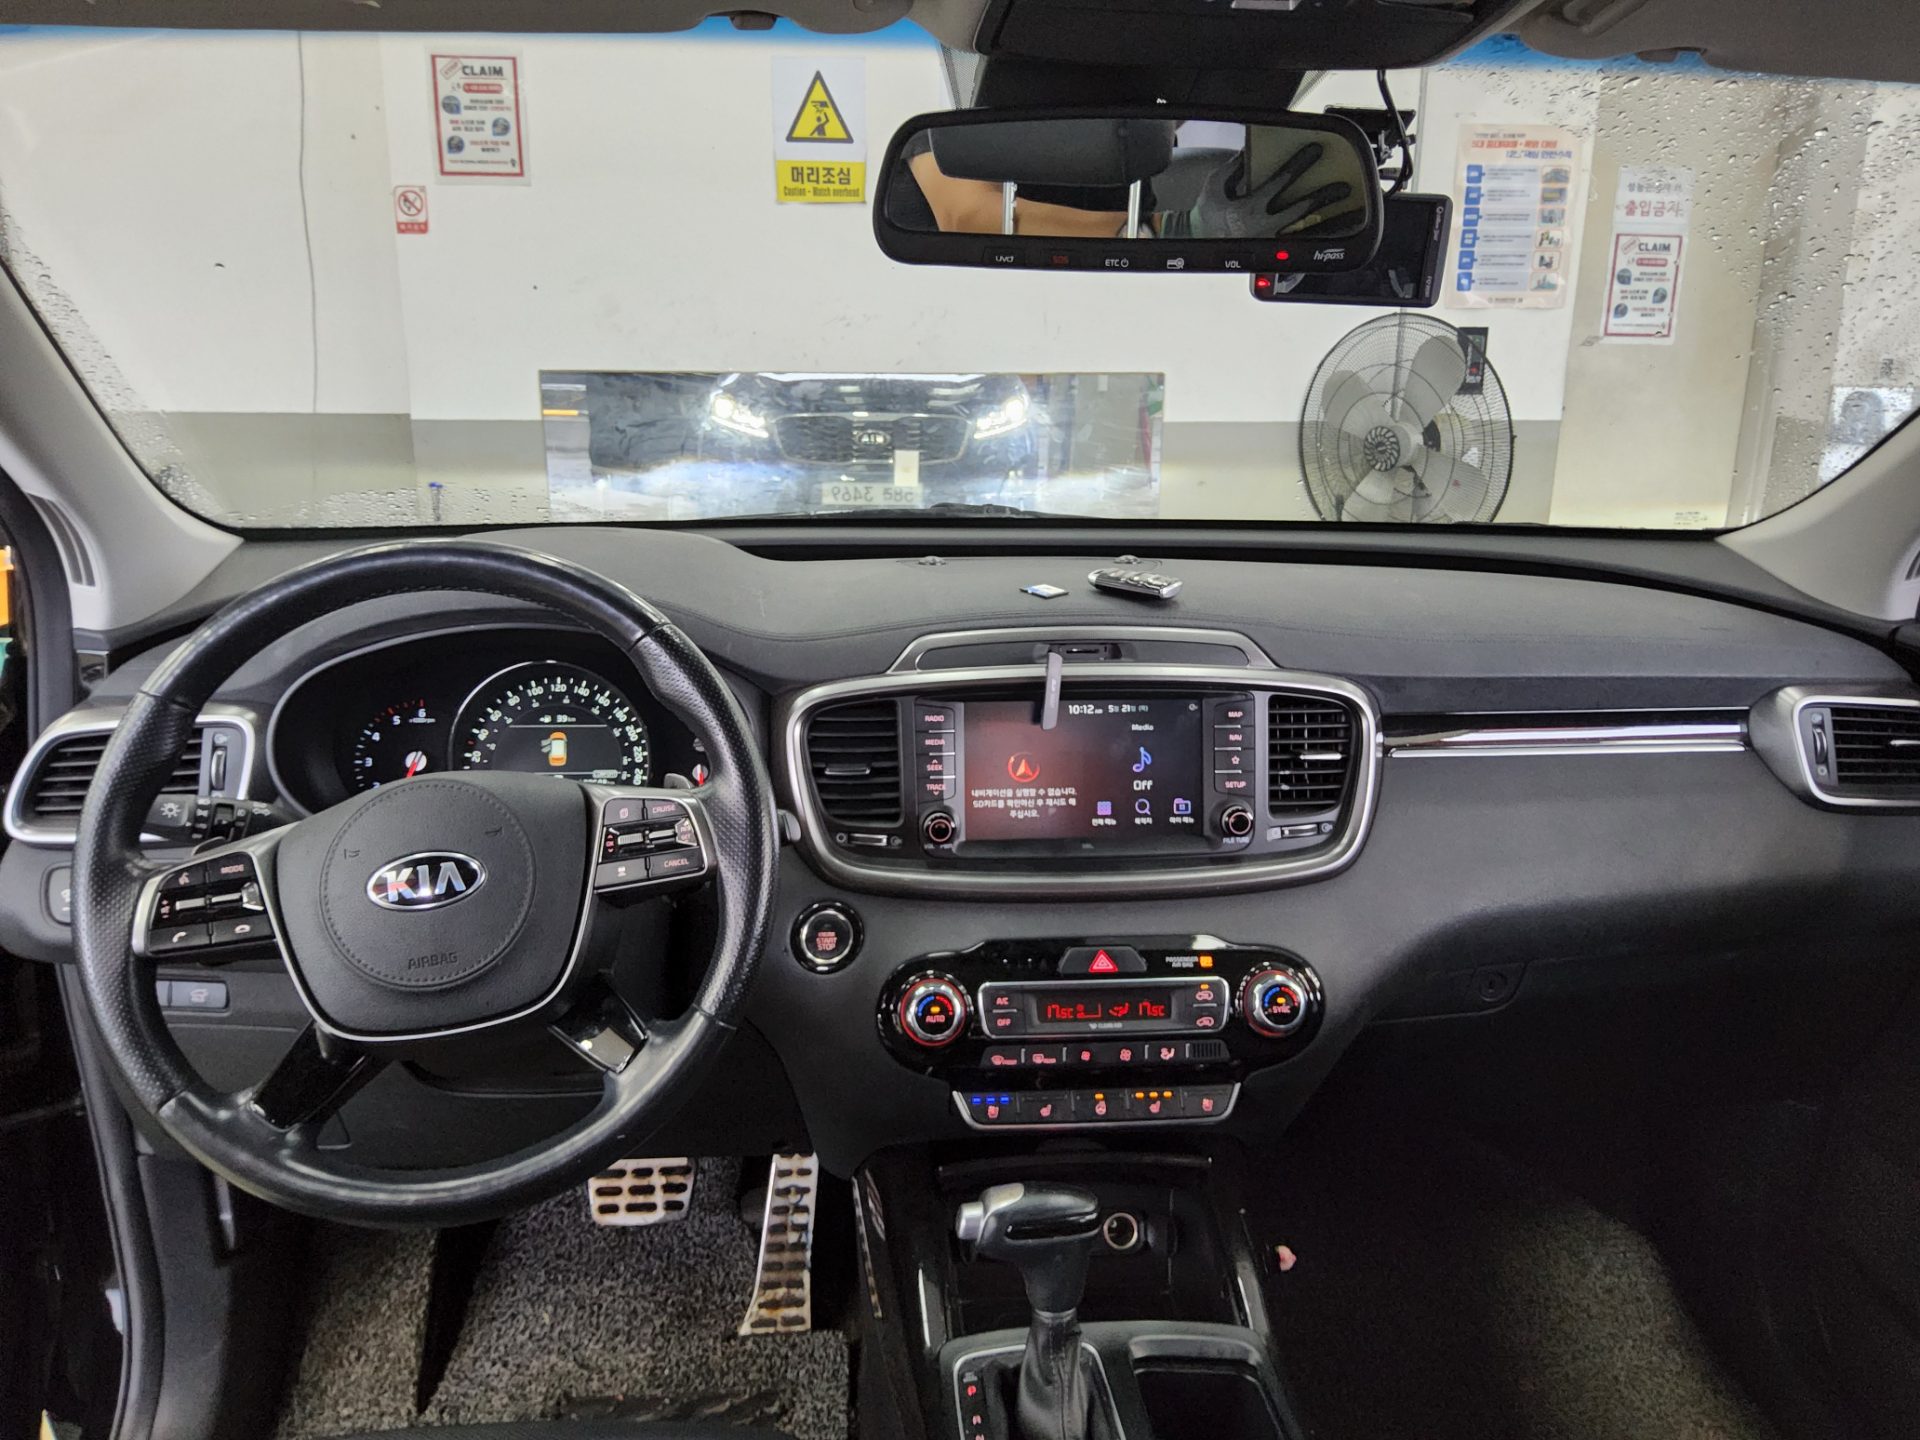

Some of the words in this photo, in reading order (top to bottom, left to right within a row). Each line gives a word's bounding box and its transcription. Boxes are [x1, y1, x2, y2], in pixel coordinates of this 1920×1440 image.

[461, 65, 504, 77] CLAIM
[791, 166, 851, 185] 머리조심
[784, 186, 806, 197] Caution
[813, 186, 831, 197] Watch
[832, 187, 860, 198] overhead
[1638, 242, 1672, 252] CLAIM
[1105, 258, 1120, 267] ETC
[1224, 260, 1241, 269] VOL
[527, 685, 544, 697] 100
[550, 683, 567, 693] 120
[573, 685, 590, 697] 140
[508, 695, 520, 707] 80
[595, 693, 610, 707] 160
[418, 708, 426, 718] 6
[613, 706, 628, 722] 180
[1068, 704, 1094, 714] 10:12
[392, 715, 401, 726] 5
[490, 709, 502, 722] 60
[925, 714, 945, 722] RADIO
[1131, 723, 1154, 731] Media
[371, 731, 381, 742] 4
[478, 728, 489, 740] 40
[625, 724, 639, 742] 200
[925, 738, 945, 746] MEDIA
[471, 750, 481, 763] 20
[633, 745, 644, 763] 220
[364, 756, 373, 768] 3
[633, 767, 643, 785] 240
[926, 783, 946, 791] TRACK
[1133, 780, 1153, 791] Off
[1016, 788, 1036, 797] 실행할
[1038, 788, 1046, 797] 수
[972, 799, 1005, 808] SD카드를
[1046, 797, 1067, 807] 재시도
[652, 804, 676, 814] CRUISE
[1010, 809, 1040, 819] 주십시오.
[664, 858, 689, 867] CANCEL
[221, 864, 244, 874] MODE
[380, 861, 467, 903] KIA
[408, 952, 458, 970] AIRBAG
[1272, 1005, 1290, 1013] SYNC
[997, 1018, 1011, 1027] OFF
[967, 1385, 976, 1396] P
